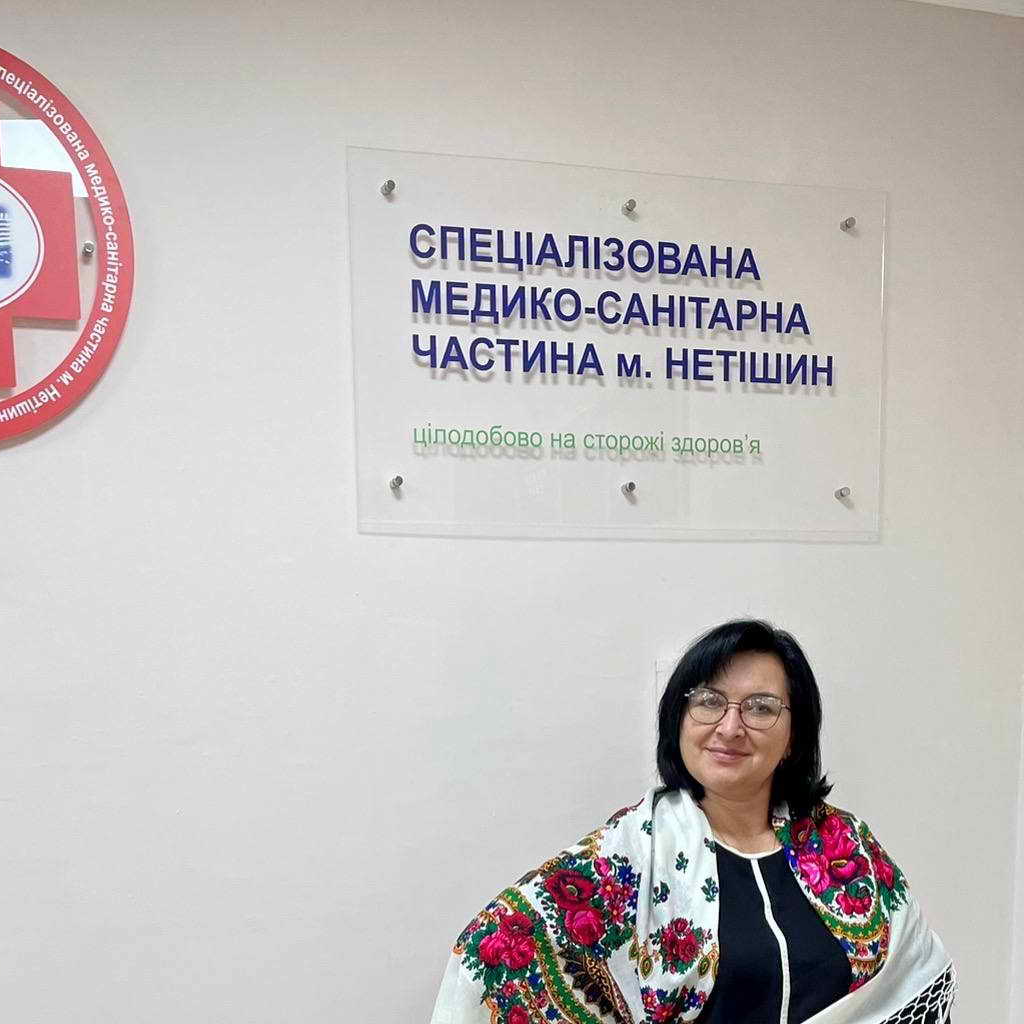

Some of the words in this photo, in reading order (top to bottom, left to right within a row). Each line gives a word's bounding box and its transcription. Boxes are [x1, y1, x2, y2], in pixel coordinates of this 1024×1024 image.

[84, 161, 123, 313] медико-санітарна
[409, 223, 761, 281] СПЕЦІАЛІЗОВАНА
[411, 279, 810, 335] МЕДИКО-САНІТАРНА
[70, 317, 110, 374] частина
[412, 334, 604, 376] ЧАСТИНА
[617, 353, 652, 378] м.
[666, 347, 833, 386] НЕТІШИН
[57, 370, 74, 386] м.
[413, 423, 543, 449] цілодобово
[550, 434, 576, 449] на
[583, 431, 664, 456] сторожі
